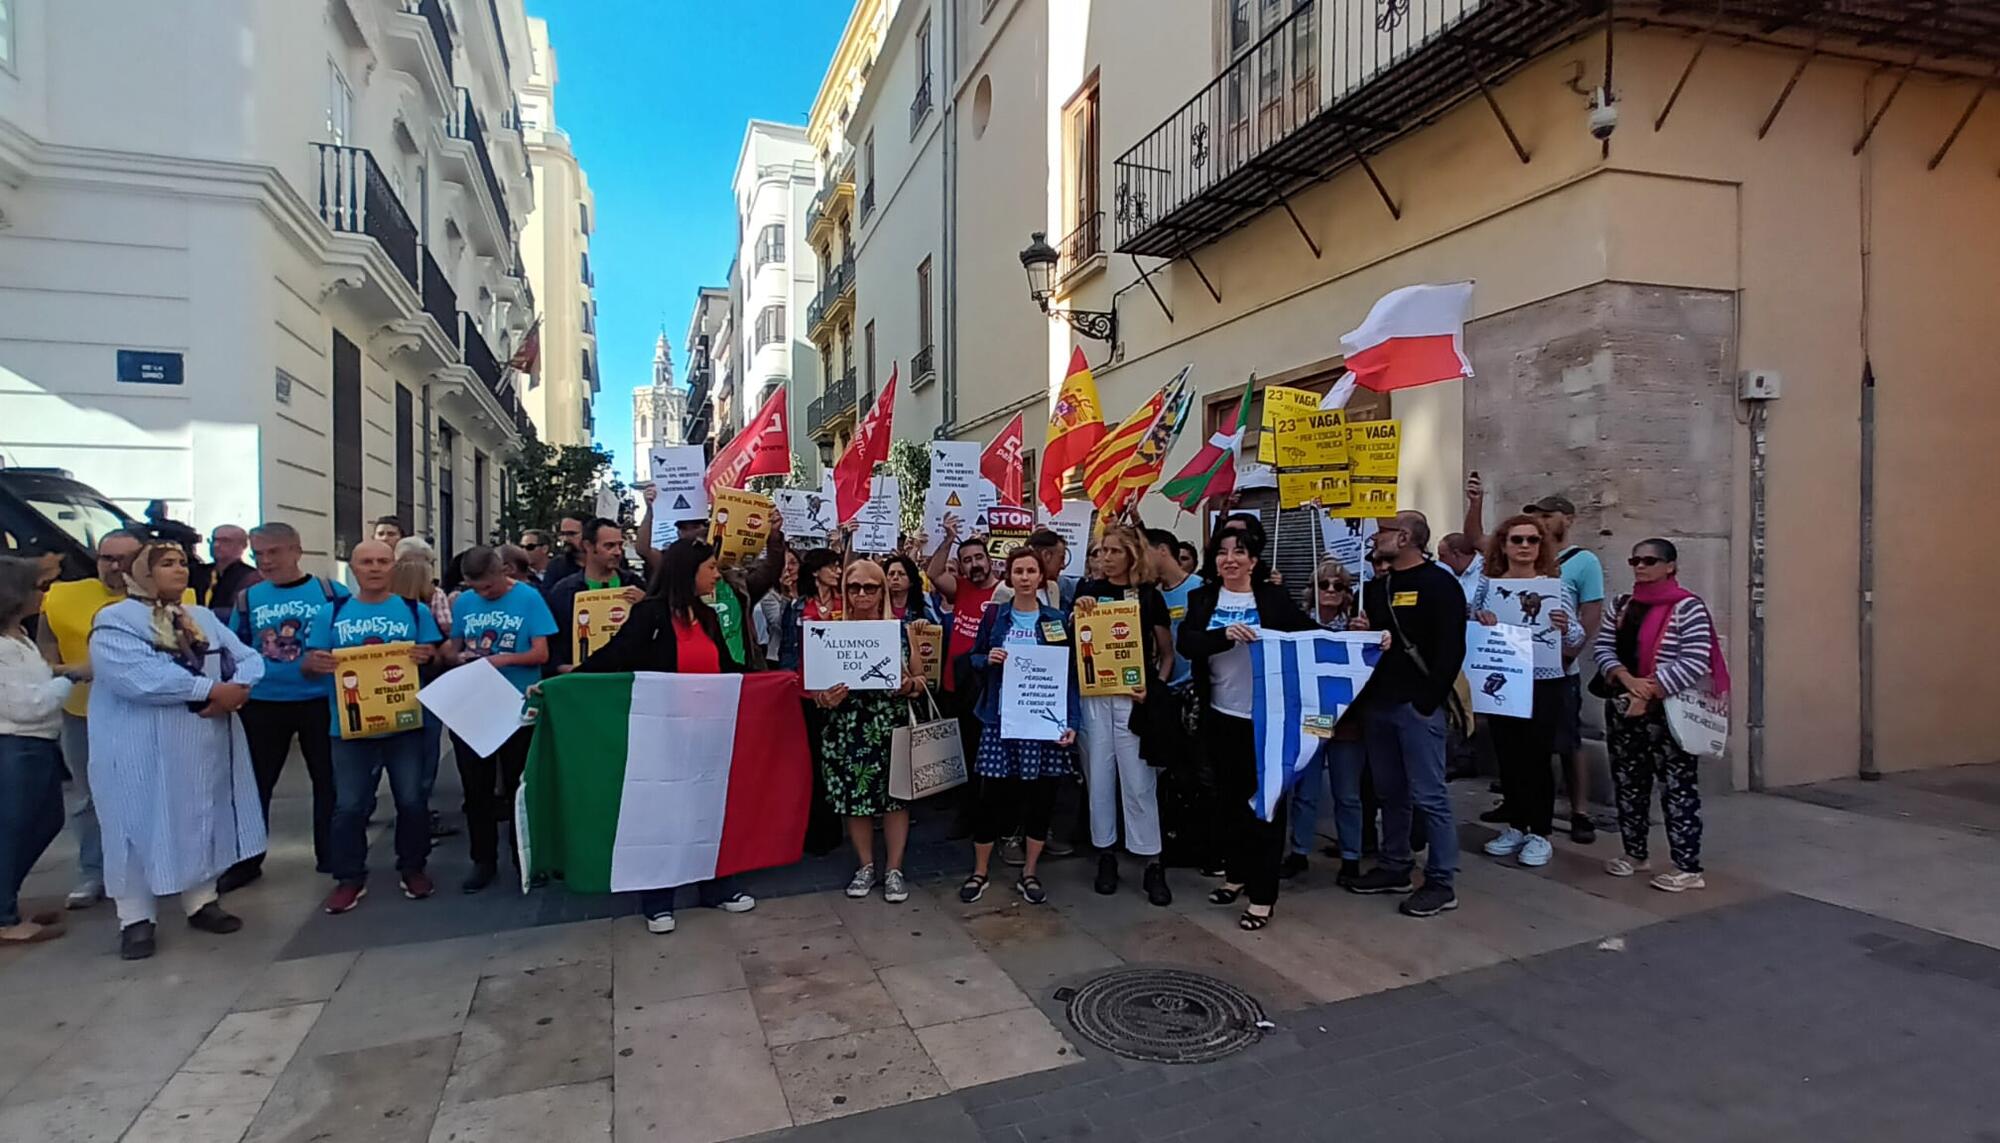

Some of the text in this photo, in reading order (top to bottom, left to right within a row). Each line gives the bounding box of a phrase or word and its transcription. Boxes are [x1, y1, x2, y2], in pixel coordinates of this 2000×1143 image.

[1267, 390, 1318, 408] 23 VAGA
[1278, 413, 1342, 433] 23 VAGA
[1365, 425, 1396, 440] VAGA
[1300, 434, 1313, 442] PER
[988, 511, 1032, 527] STOP
[741, 537, 756, 546] EOI
[1102, 608, 1113, 616] HA
[1111, 626, 1130, 636] STOP
[824, 639, 880, 648] ALUMNOS
[836, 650, 868, 660] DE LA
[1114, 650, 1131, 660] EOI
[842, 661, 862, 671] EOI
[386, 694, 406, 705] EOI
